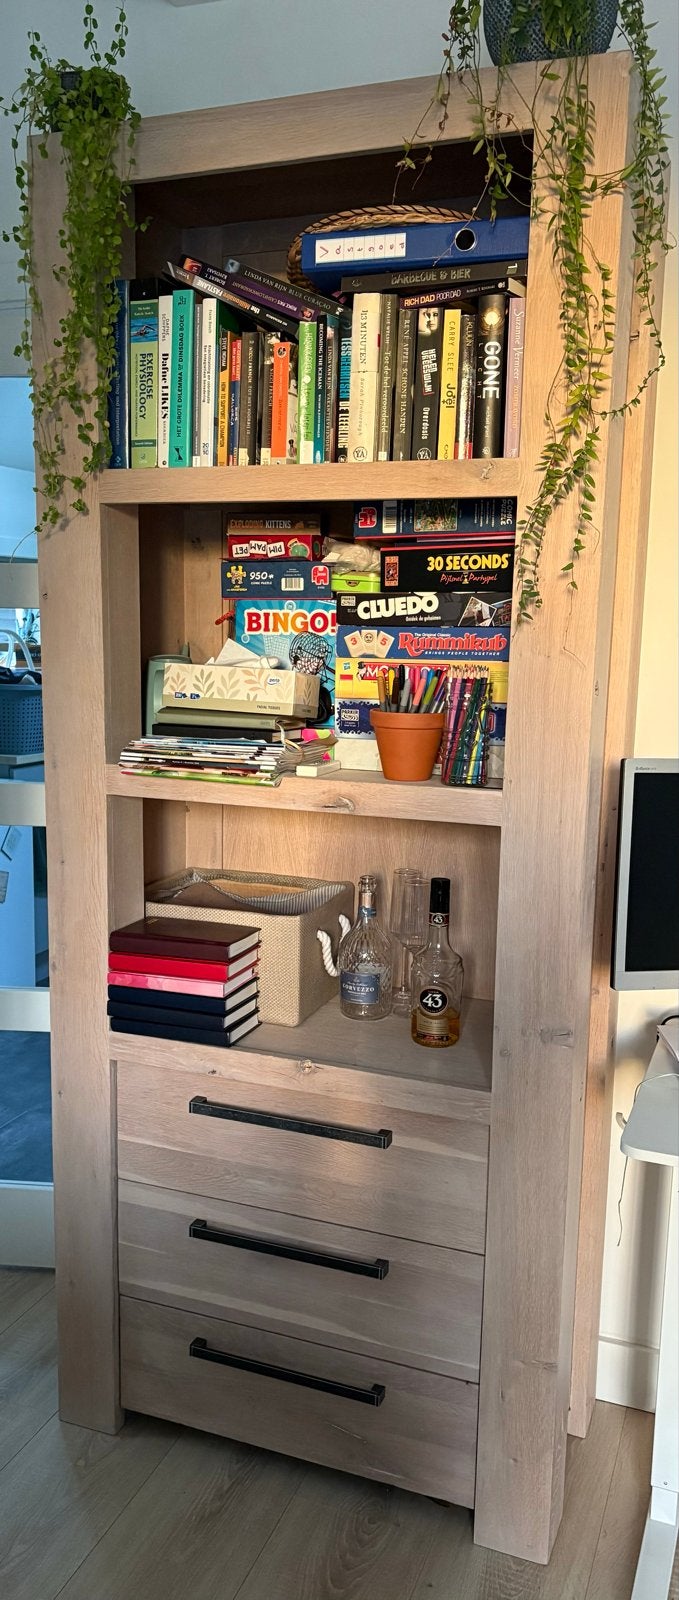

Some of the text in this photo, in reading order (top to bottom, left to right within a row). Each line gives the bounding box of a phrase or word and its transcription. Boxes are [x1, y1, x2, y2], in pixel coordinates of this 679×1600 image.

[211, 275, 225, 285] ROBERT
[244, 270, 262, 281] LINDA
[262, 277, 273, 286] VAN
[275, 281, 287, 291] RIJN
[289, 286, 302, 298] BLUE
[391, 269, 471, 284] BARBECUE & BIER
[196, 279, 223, 296] FASTLANE
[223, 292, 251, 310] Millionaire
[251, 305, 260, 314] the
[404, 297, 419, 306] RICH
[420, 295, 435, 303] DAD
[403, 320, 411, 339] RENÉ
[514, 309, 524, 345] Suzanne
[341, 337, 351, 356] TESS
[359, 323, 367, 364] MINUTEN
[383, 351, 391, 363] Tot
[429, 349, 438, 372] HELEN
[512, 346, 523, 380] Vermeer
[161, 353, 169, 383] Dafne
[384, 366, 390, 374] de
[482, 341, 501, 399] GONE
[445, 384, 456, 408] Joël
[338, 401, 350, 448] DE LEERLING
[421, 407, 430, 439] Overdosis
[231, 520, 291, 528] EXPLODING KITTENS
[251, 543, 266, 551] PAM
[270, 545, 282, 553] PIM
[427, 553, 509, 571] 30 SECONDS
[357, 594, 439, 619] CLUEDO
[247, 612, 336, 633] BINGO!
[380, 637, 388, 646] 5
[398, 632, 507, 657] Rummikub
[434, 915, 443, 923] 43
[422, 993, 443, 1008] 43
